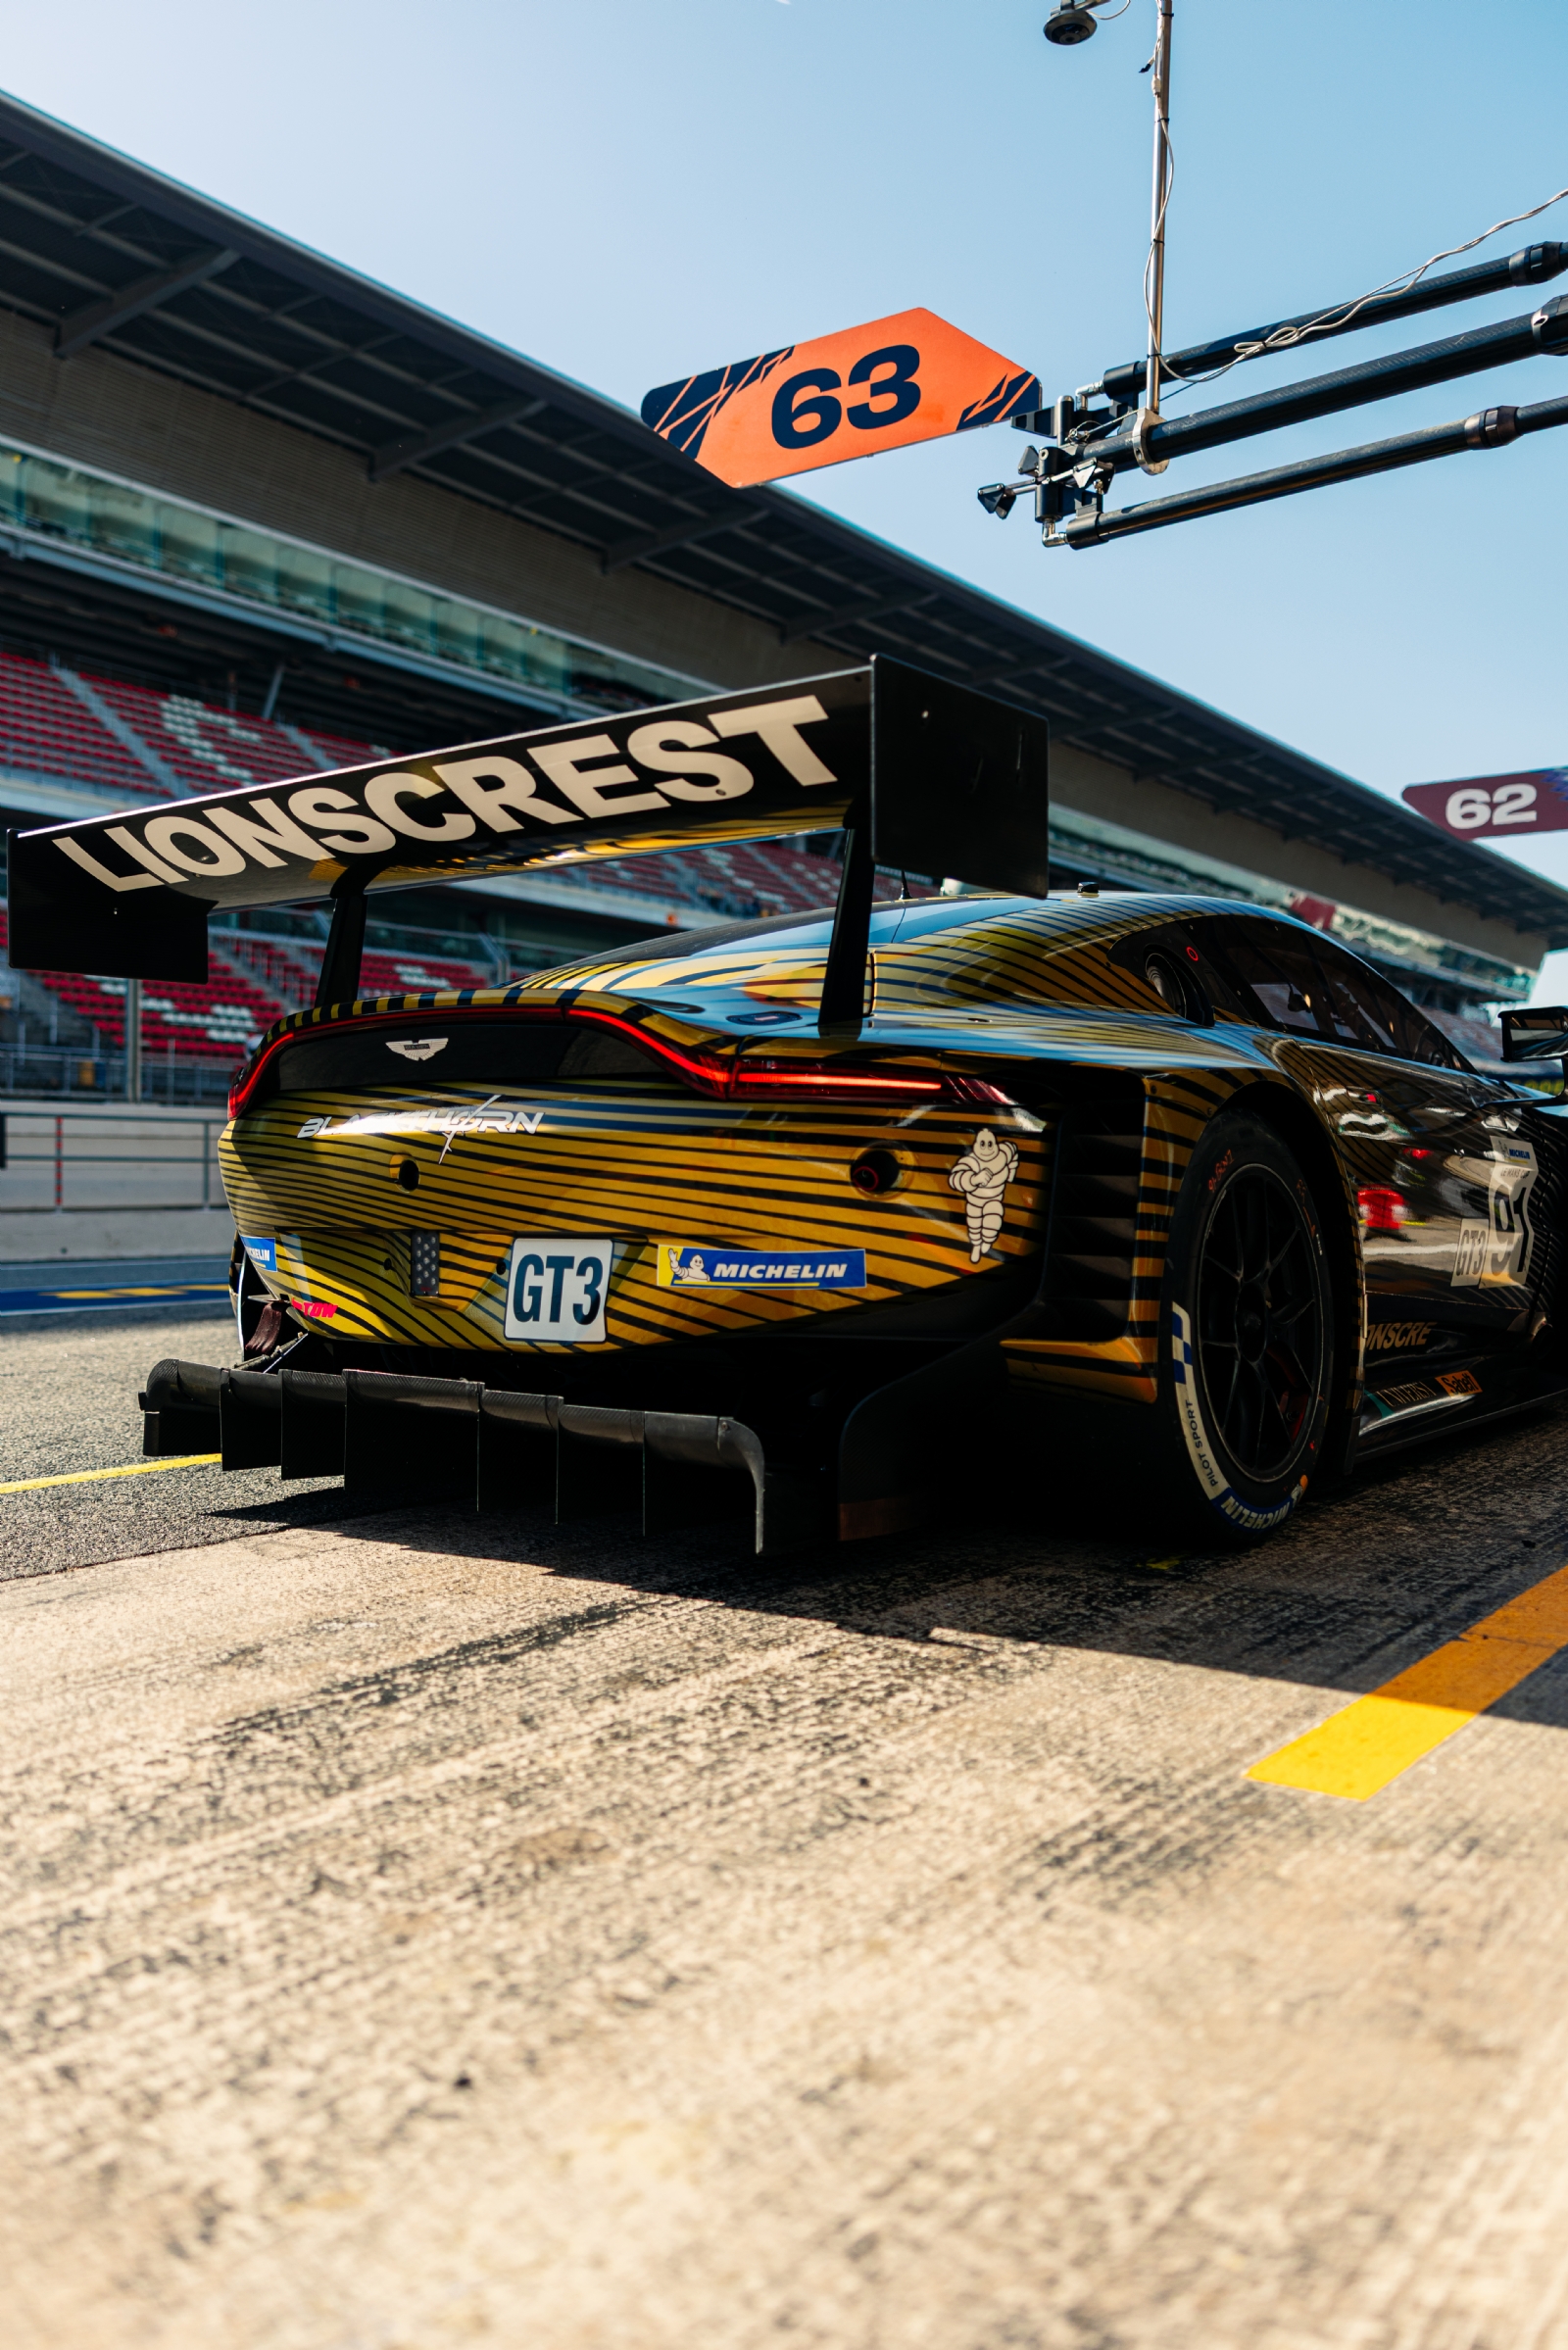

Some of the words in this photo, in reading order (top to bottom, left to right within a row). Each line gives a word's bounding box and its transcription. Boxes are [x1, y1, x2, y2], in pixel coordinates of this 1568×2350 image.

[771, 344, 921, 450] 63
[52, 696, 838, 892] LIONSCREST
[1446, 782, 1538, 830] 62
[1508, 1149, 1531, 1159] MICHELIN
[1490, 1184, 1529, 1276] 91
[713, 1263, 848, 1279] MICHELIN
[1456, 1229, 1487, 1277] GT3
[303, 1301, 338, 1319] TOW
[513, 1253, 604, 1326] GT3
[1366, 1321, 1438, 1350] ONSCRE
[1441, 1372, 1479, 1395] Sabelt
[1185, 1398, 1203, 1449] SPORT
[1198, 1452, 1219, 1488] PILOT
[1220, 1494, 1291, 1530] MICHELIN
